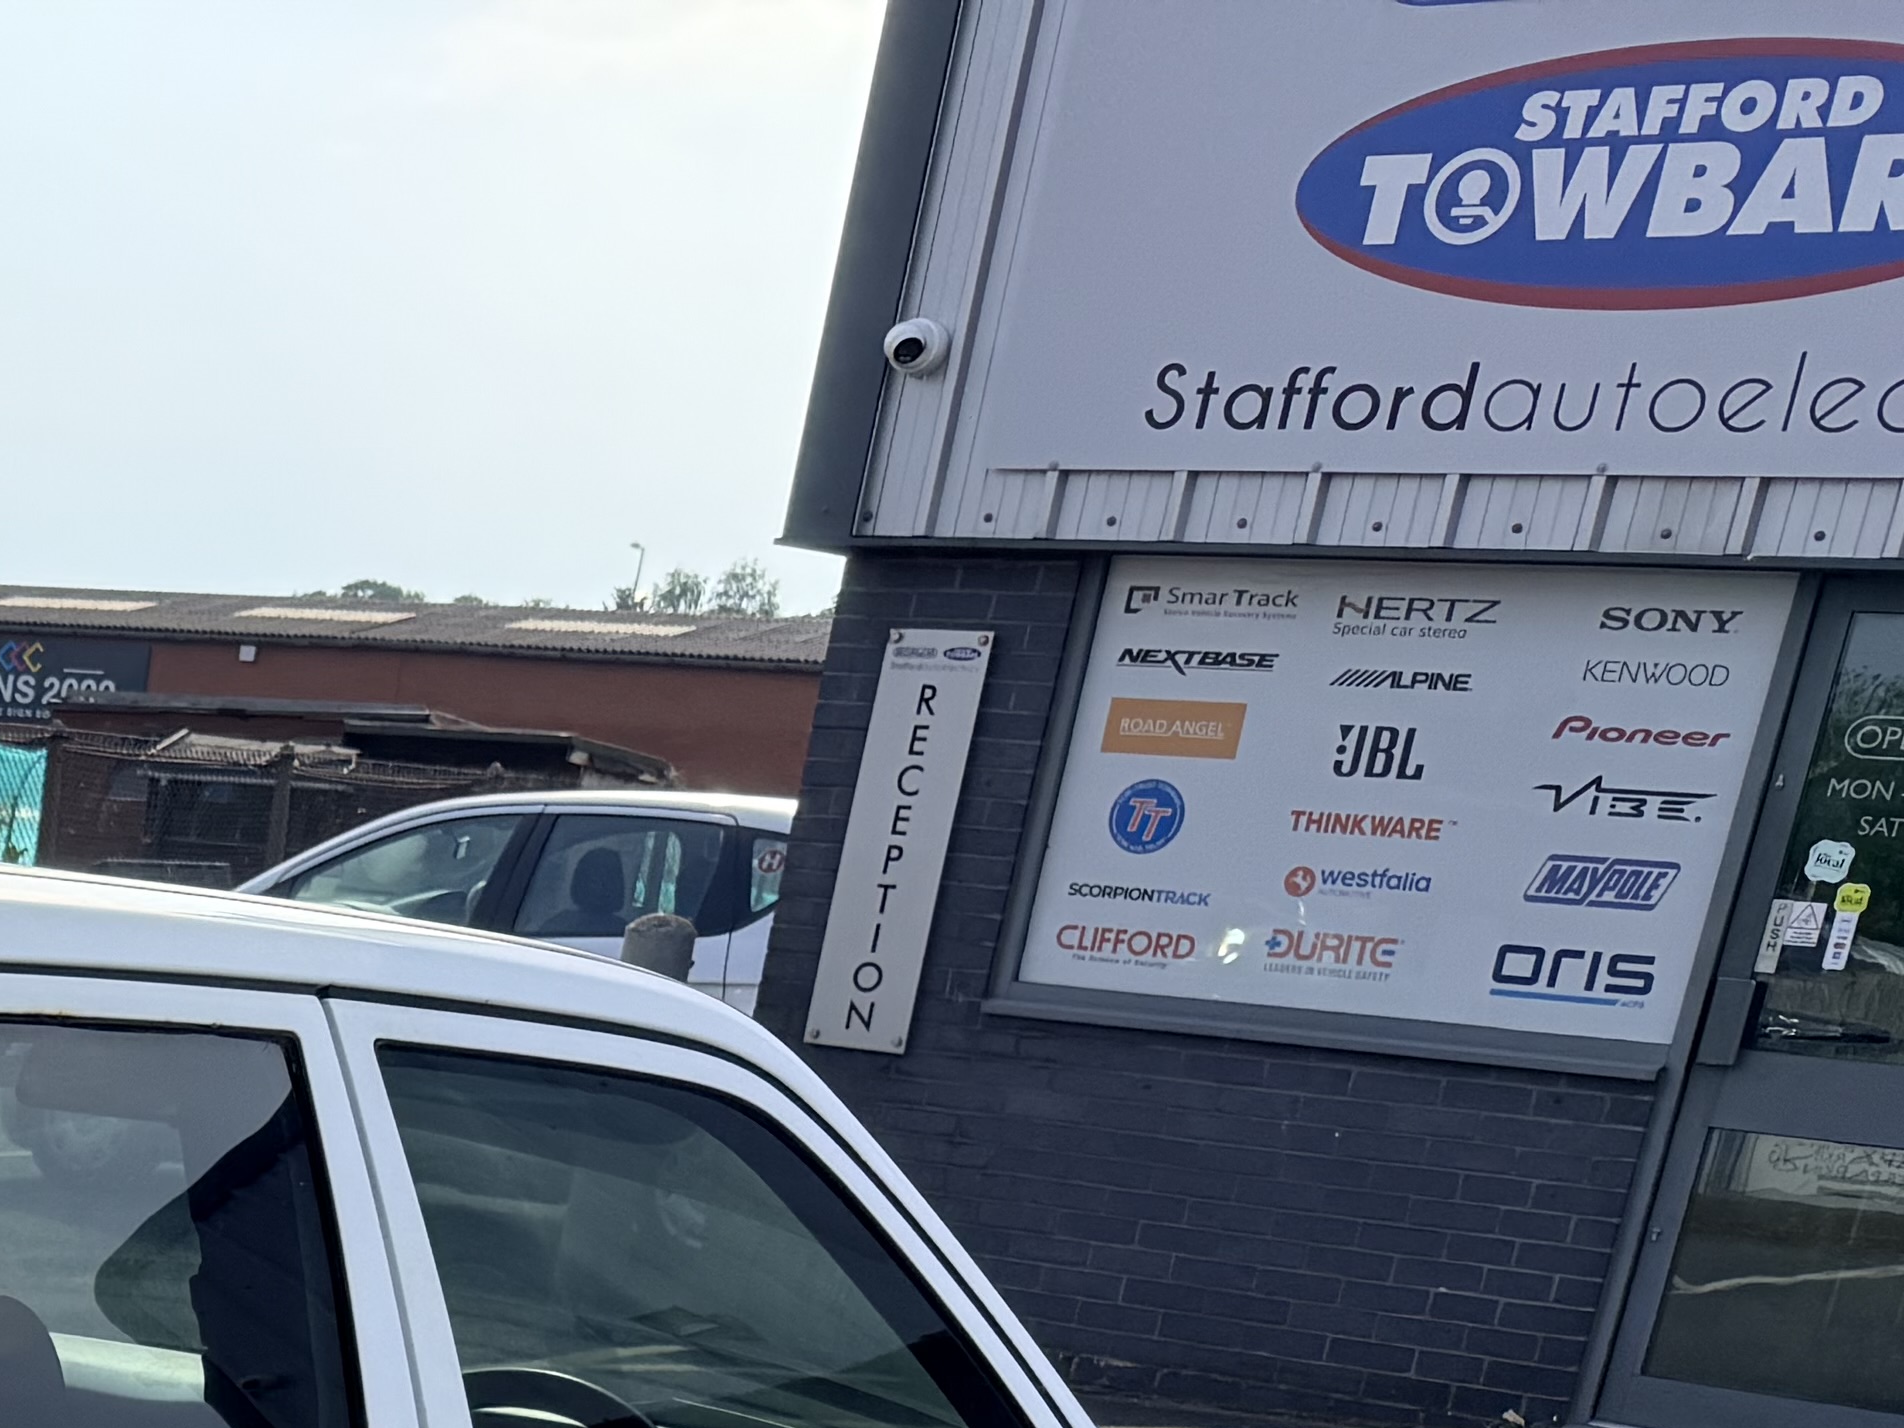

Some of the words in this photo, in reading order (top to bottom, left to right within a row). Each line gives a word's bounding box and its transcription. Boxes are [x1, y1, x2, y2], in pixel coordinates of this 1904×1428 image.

[1514, 75, 1884, 141] STAFFORD
[1336, 595, 1502, 624] HERTZ
[1599, 607, 1743, 633] SONY
[1332, 622, 1386, 638] Special
[1390, 625, 1413, 637] car
[1418, 627, 1467, 639] stereo
[1117, 648, 1279, 676] NEXTBASE
[1582, 659, 1730, 687] KENWOOD
[1348, 668, 1472, 692] ALPINE
[1120, 717, 1167, 735] ROAD
[1169, 719, 1225, 739] ANGEL
[1552, 715, 1731, 747] Pioneer
[1857, 725, 1904, 750] OP
[1333, 724, 1425, 779] JBL
[1827, 778, 1895, 800] MON
[1290, 810, 1444, 841] THINKWARE
[1857, 816, 1904, 837] SAT
[845, 684, 937, 1031] RECEPTION
[1068, 882, 1211, 907] SCORPIONTRACK
[1320, 868, 1432, 893] westfalia
[1535, 863, 1669, 902] MAYPOLE
[1766, 902, 1788, 952] PUSH
[1056, 924, 1195, 960] CLIFFORD
[1266, 929, 1399, 969] DURITE
